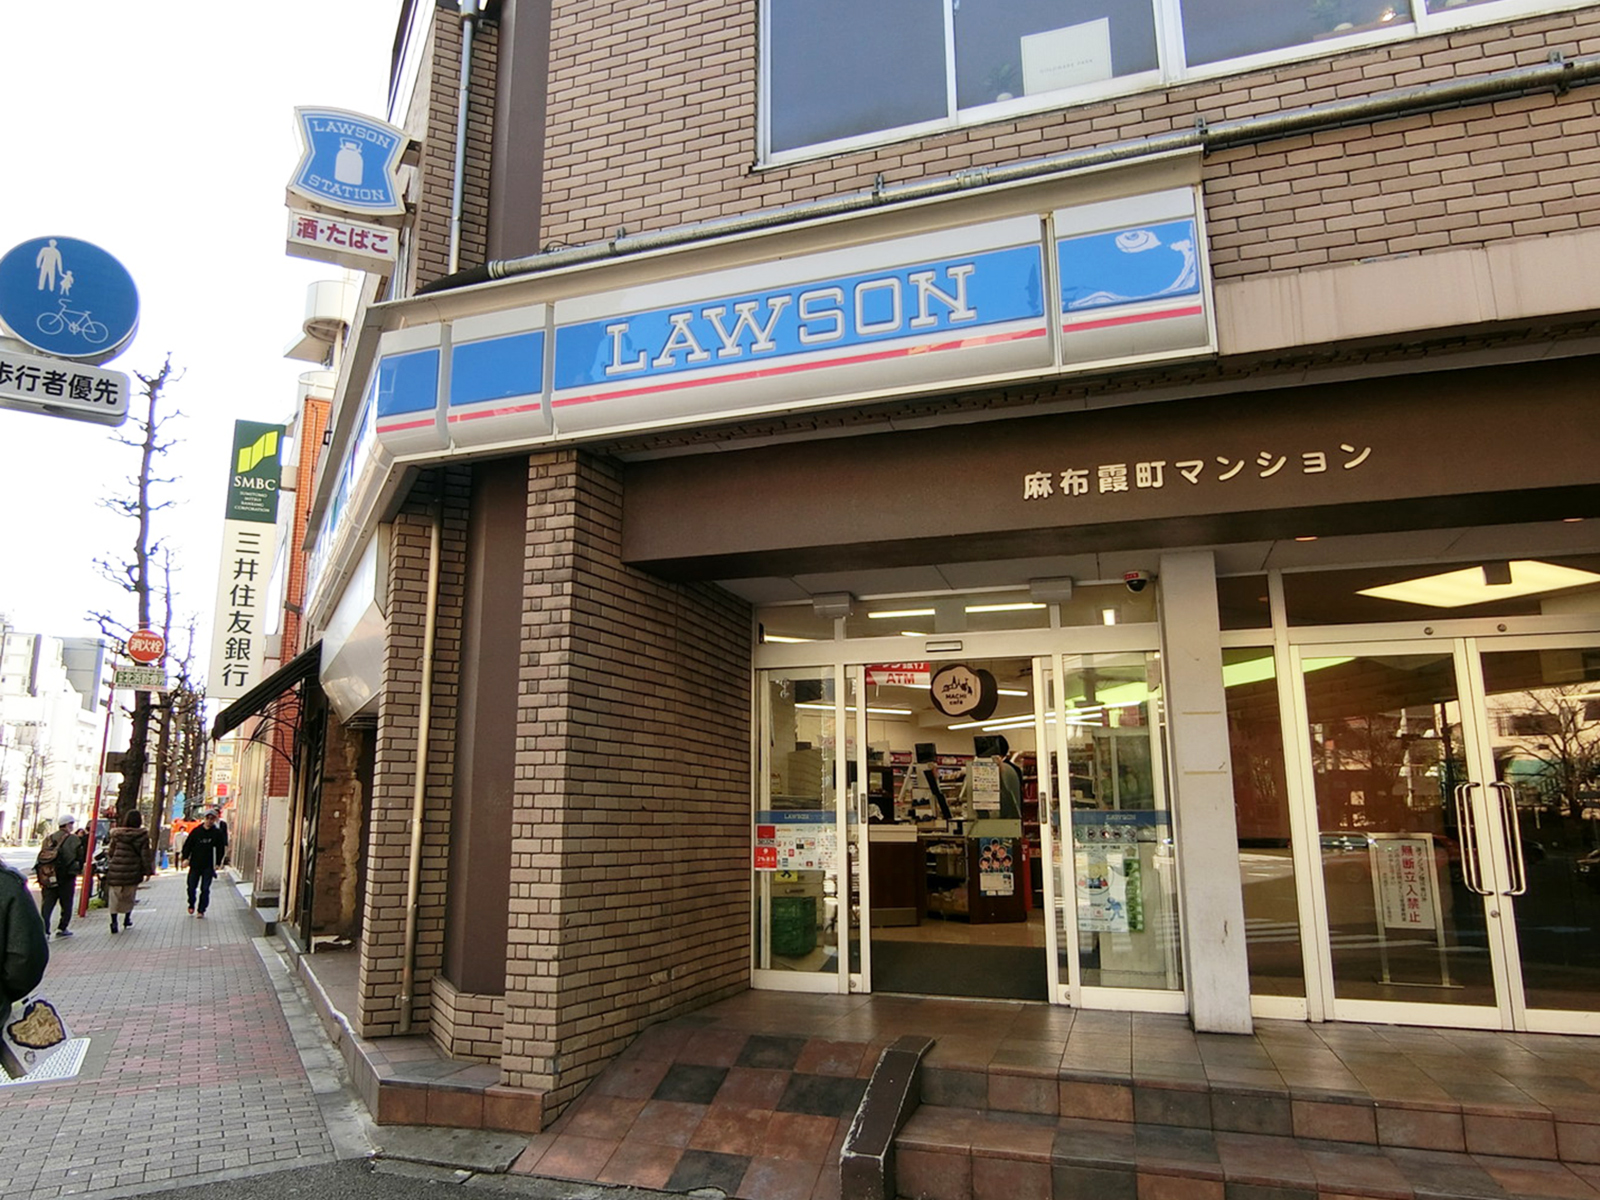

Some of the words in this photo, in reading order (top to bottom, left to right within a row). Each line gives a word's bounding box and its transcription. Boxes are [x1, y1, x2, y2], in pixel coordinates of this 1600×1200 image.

[312, 120, 391, 148] LAWSON
[308, 174, 385, 200] STATION
[296, 216, 388, 254] 酒・たばこ
[605, 263, 977, 375] LAWSON
[233, 475, 276, 491] SMBC
[1023, 443, 1372, 500] 麻布霞町マンション
[221, 531, 261, 687] 三井住友銀行
[130, 637, 163, 654] 消火栓
[886, 673, 915, 685] ATM
[1401, 844, 1421, 923] 無断立入禁止
